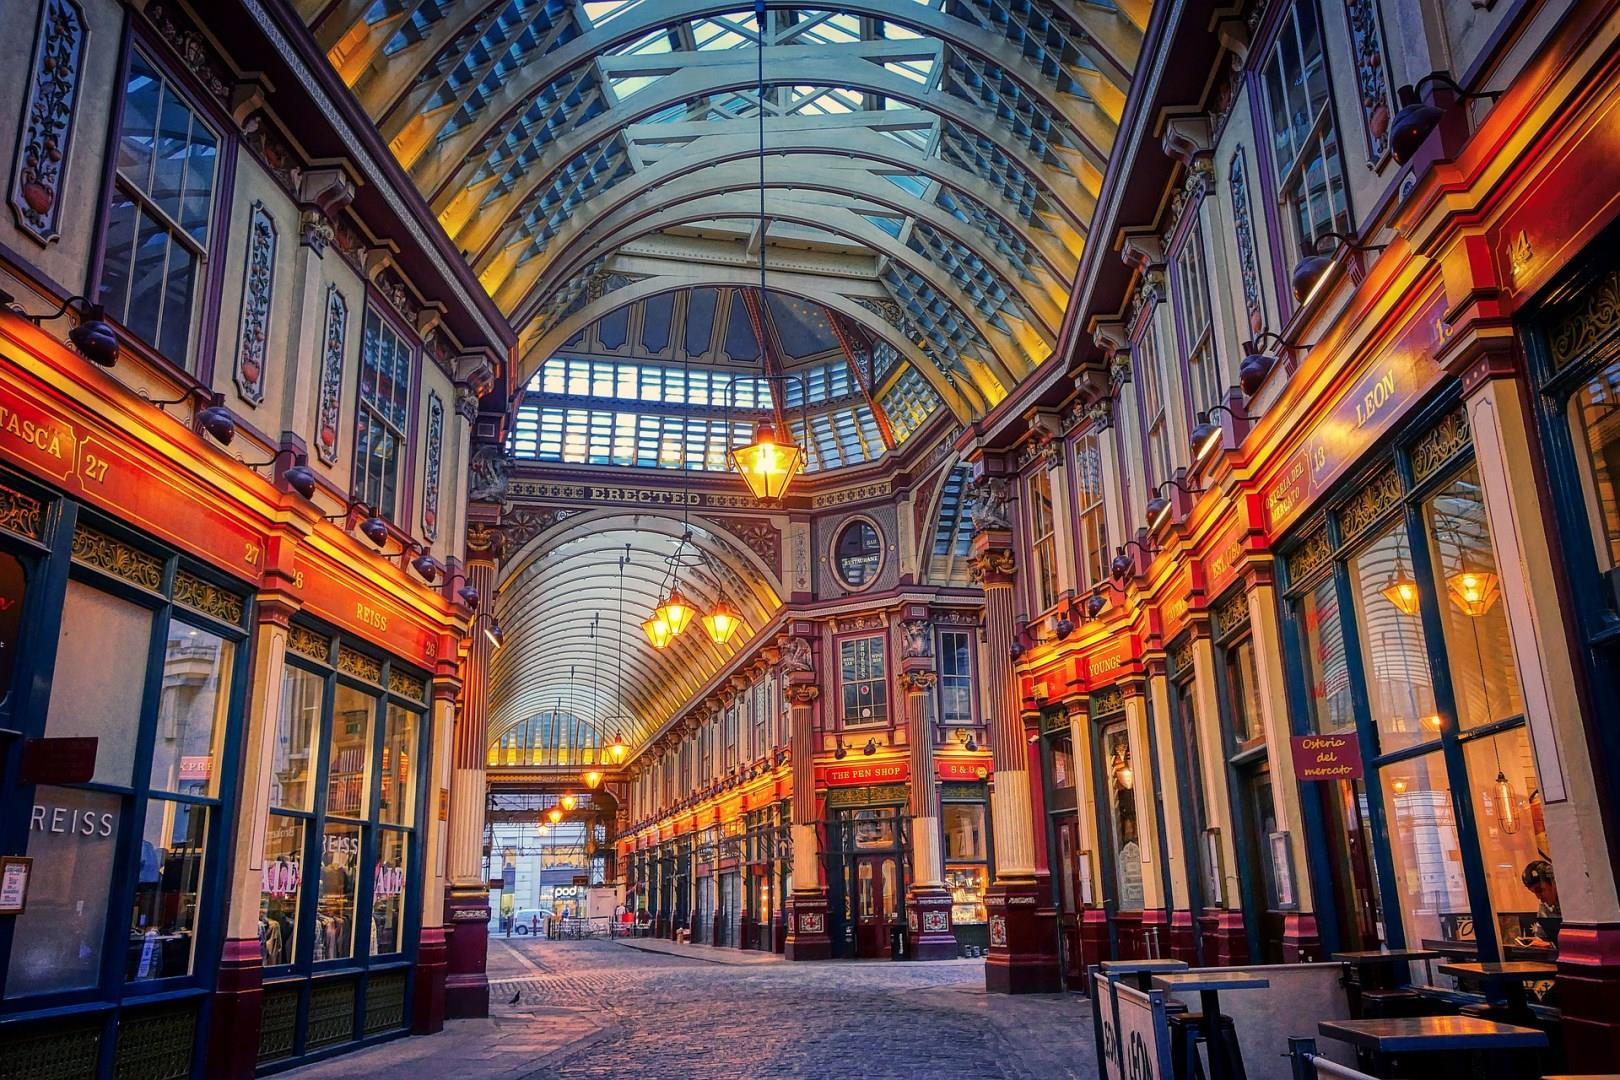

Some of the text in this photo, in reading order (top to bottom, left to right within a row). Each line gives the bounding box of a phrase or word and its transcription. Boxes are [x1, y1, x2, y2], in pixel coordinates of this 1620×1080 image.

[1356, 368, 1395, 428] LEON
[85, 454, 108, 482] 27
[1314, 445, 1326, 472] 13
[1291, 462, 1304, 482] DEL
[590, 487, 701, 506] ERECTED
[244, 543, 260, 566] 27
[356, 602, 387, 632] REISS
[425, 640, 436, 657] 26
[1089, 655, 1121, 677] YOUNGS
[1302, 737, 1346, 750] Osteria
[1316, 751, 1338, 763] del
[831, 767, 901, 780] THE PEN SHOP
[959, 765, 968, 774] &
[1304, 765, 1353, 776] mercato
[30, 805, 113, 837] REISS
[554, 885, 577, 898] pod
